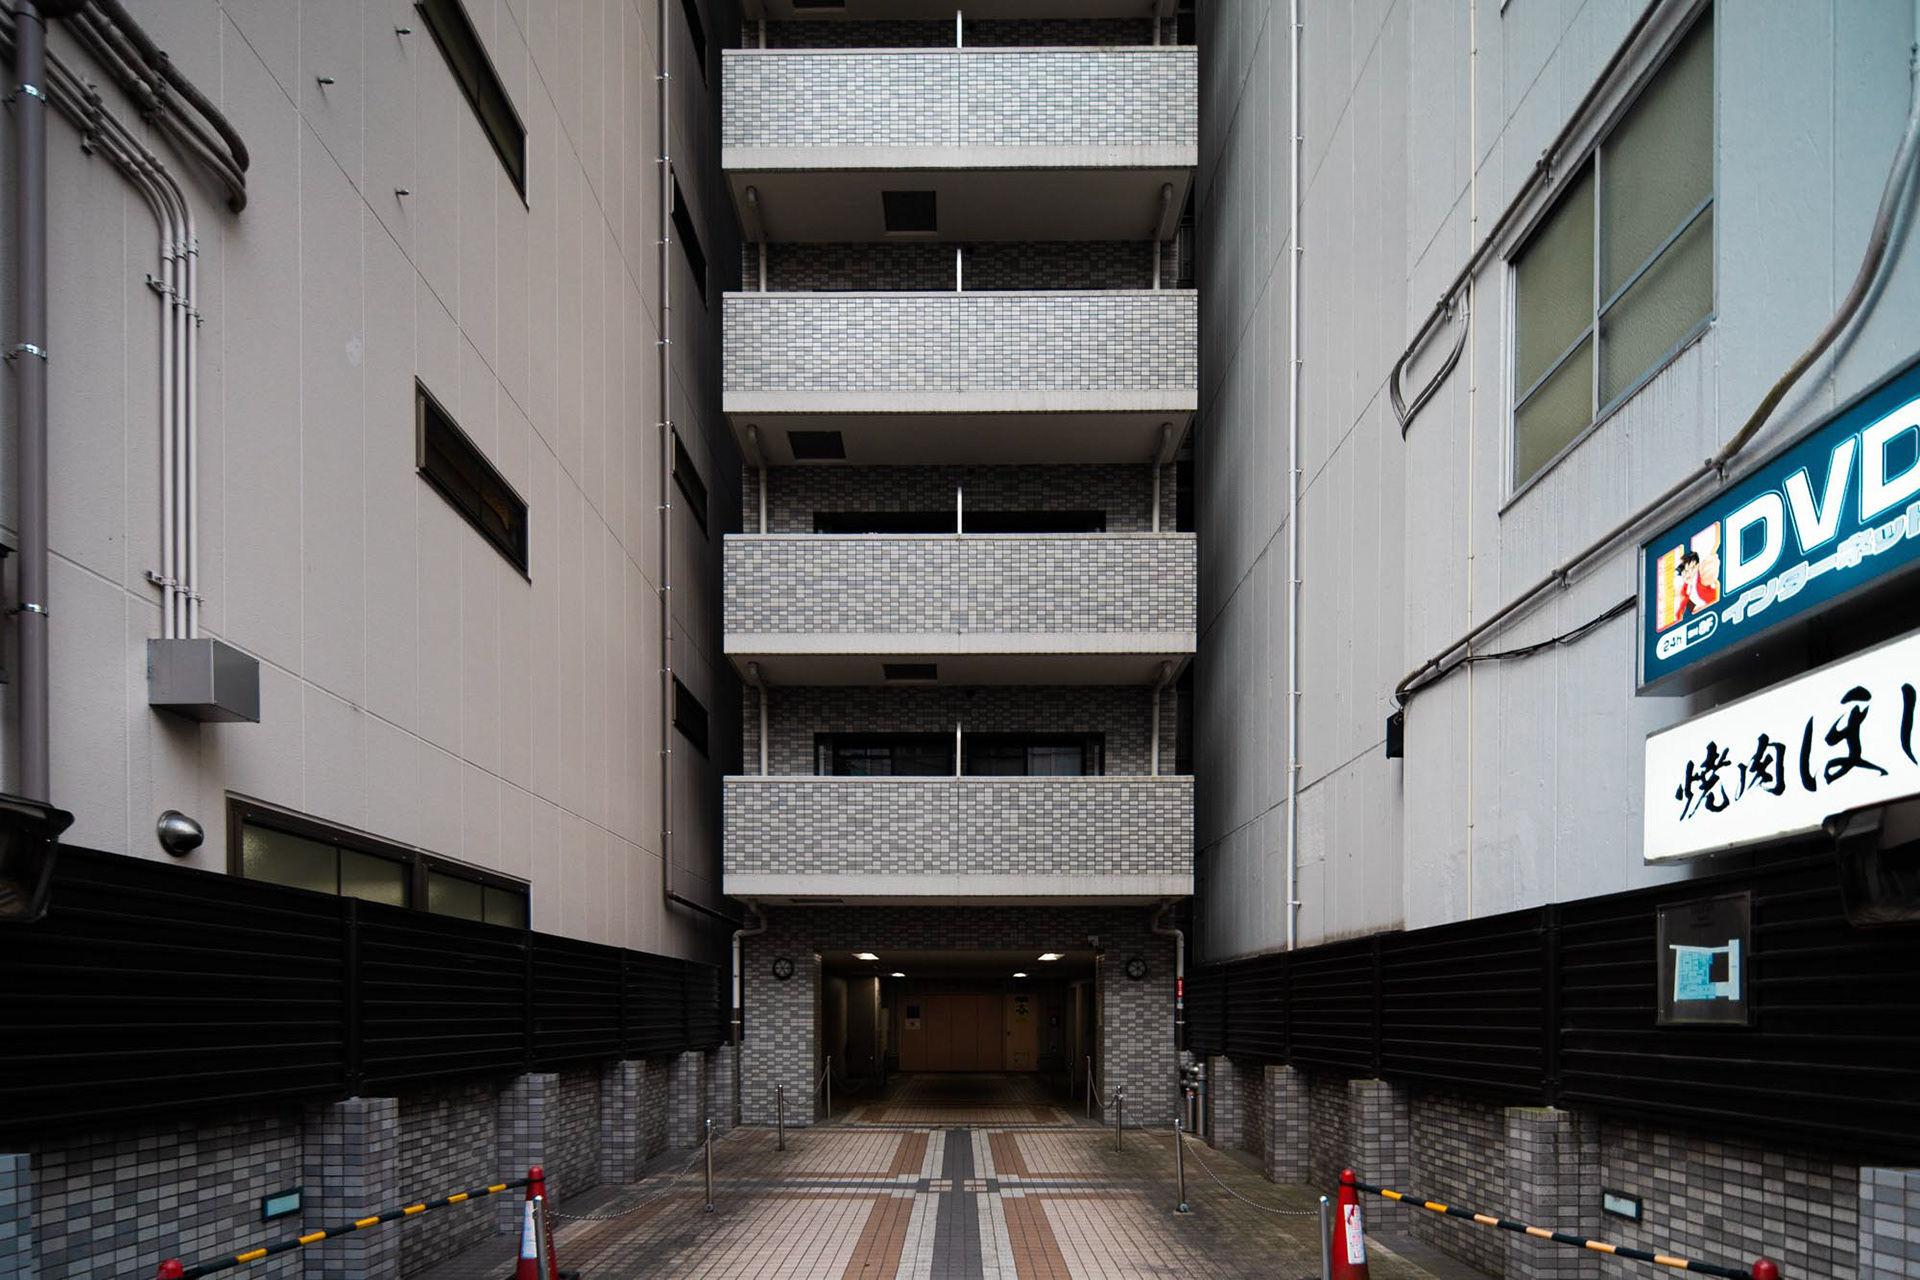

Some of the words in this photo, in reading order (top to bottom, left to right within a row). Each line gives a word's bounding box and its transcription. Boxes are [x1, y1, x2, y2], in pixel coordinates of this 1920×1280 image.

[1723, 394, 1920, 597] DVD
[1675, 682, 1918, 821] 焼肉ほ
